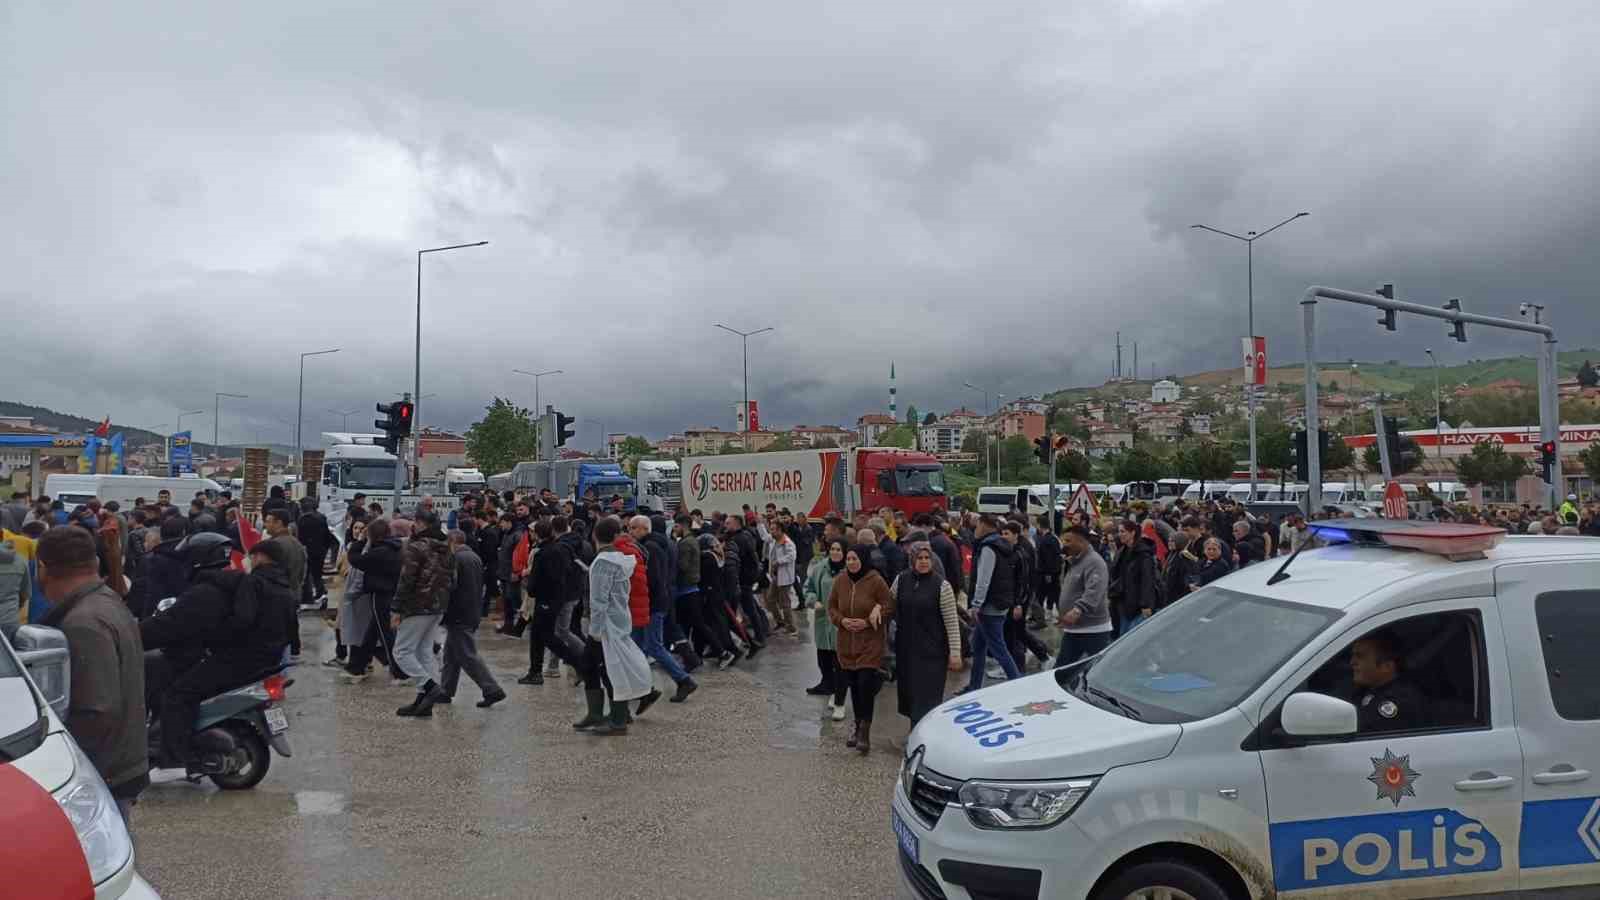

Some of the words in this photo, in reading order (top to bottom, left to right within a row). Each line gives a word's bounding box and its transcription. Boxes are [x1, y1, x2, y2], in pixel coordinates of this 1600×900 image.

[1444, 433, 1504, 444] HAVZA
[1515, 431, 1600, 443] TEMINA
[711, 471, 758, 491] SERHAT
[762, 469, 803, 491] ARAR
[942, 702, 1025, 747] POLİS
[1304, 814, 1486, 881] POLİS
